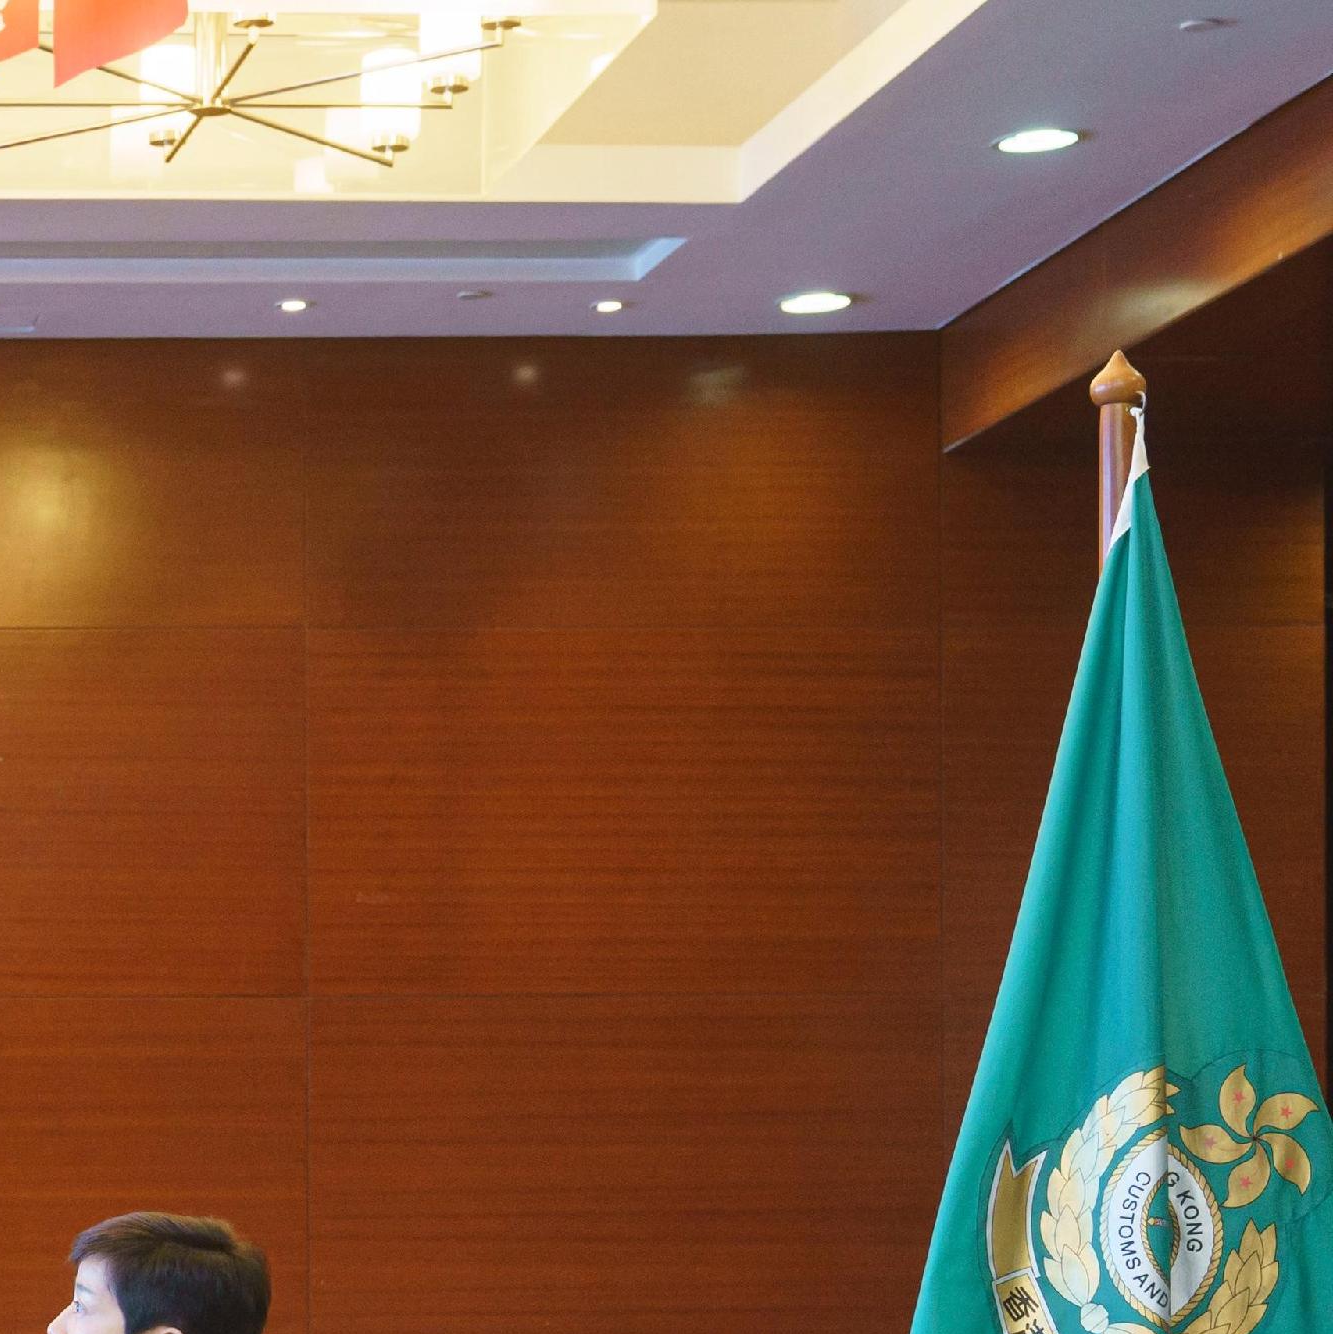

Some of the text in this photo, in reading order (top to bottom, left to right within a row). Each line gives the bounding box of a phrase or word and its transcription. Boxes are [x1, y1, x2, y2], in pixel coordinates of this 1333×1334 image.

[1117, 1171, 1170, 1310] CUSTOMS AND
[1175, 1189, 1203, 1253] KONG
